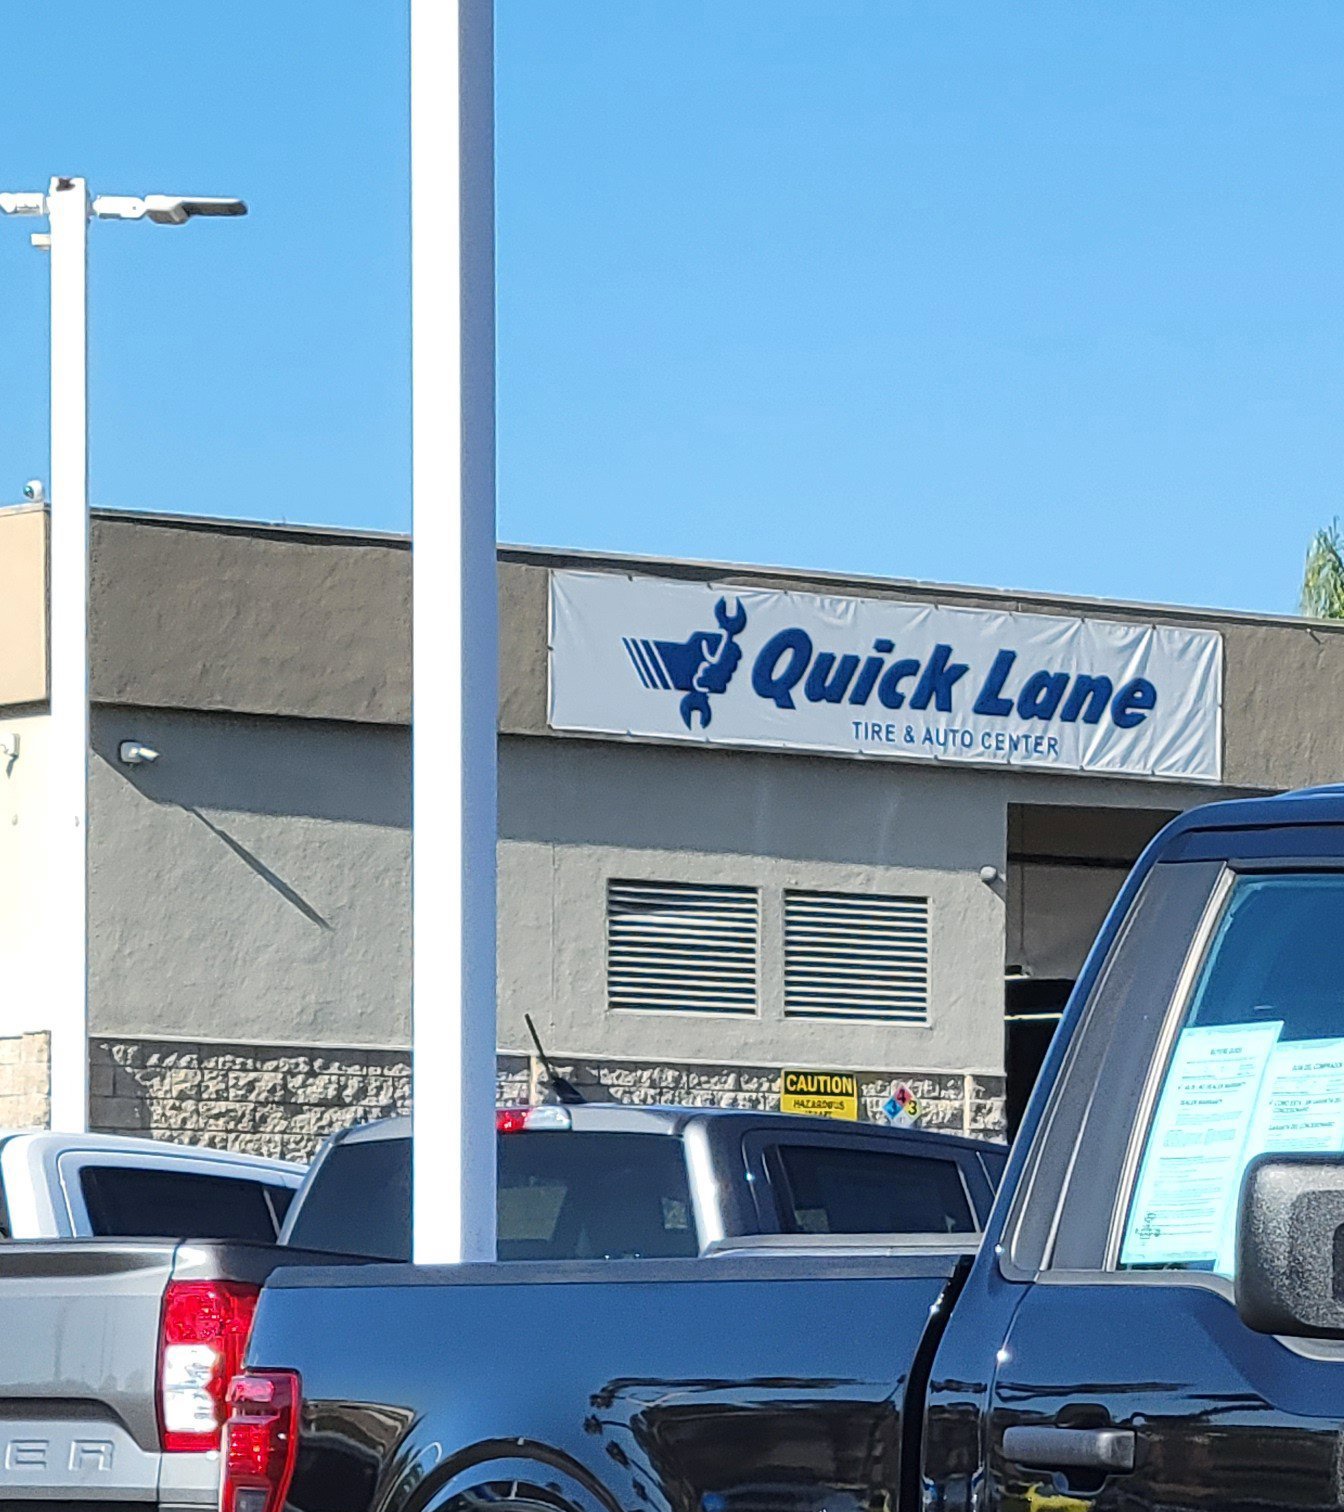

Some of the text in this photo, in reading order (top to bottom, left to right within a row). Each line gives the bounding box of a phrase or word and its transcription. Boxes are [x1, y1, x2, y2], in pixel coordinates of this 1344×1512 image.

[751, 626, 1158, 729] Quick Lane
[852, 720, 1059, 756] TIRE & AUTO CENTER
[786, 1074, 853, 1094] CAUTION
[908, 1100, 917, 1115] 3
